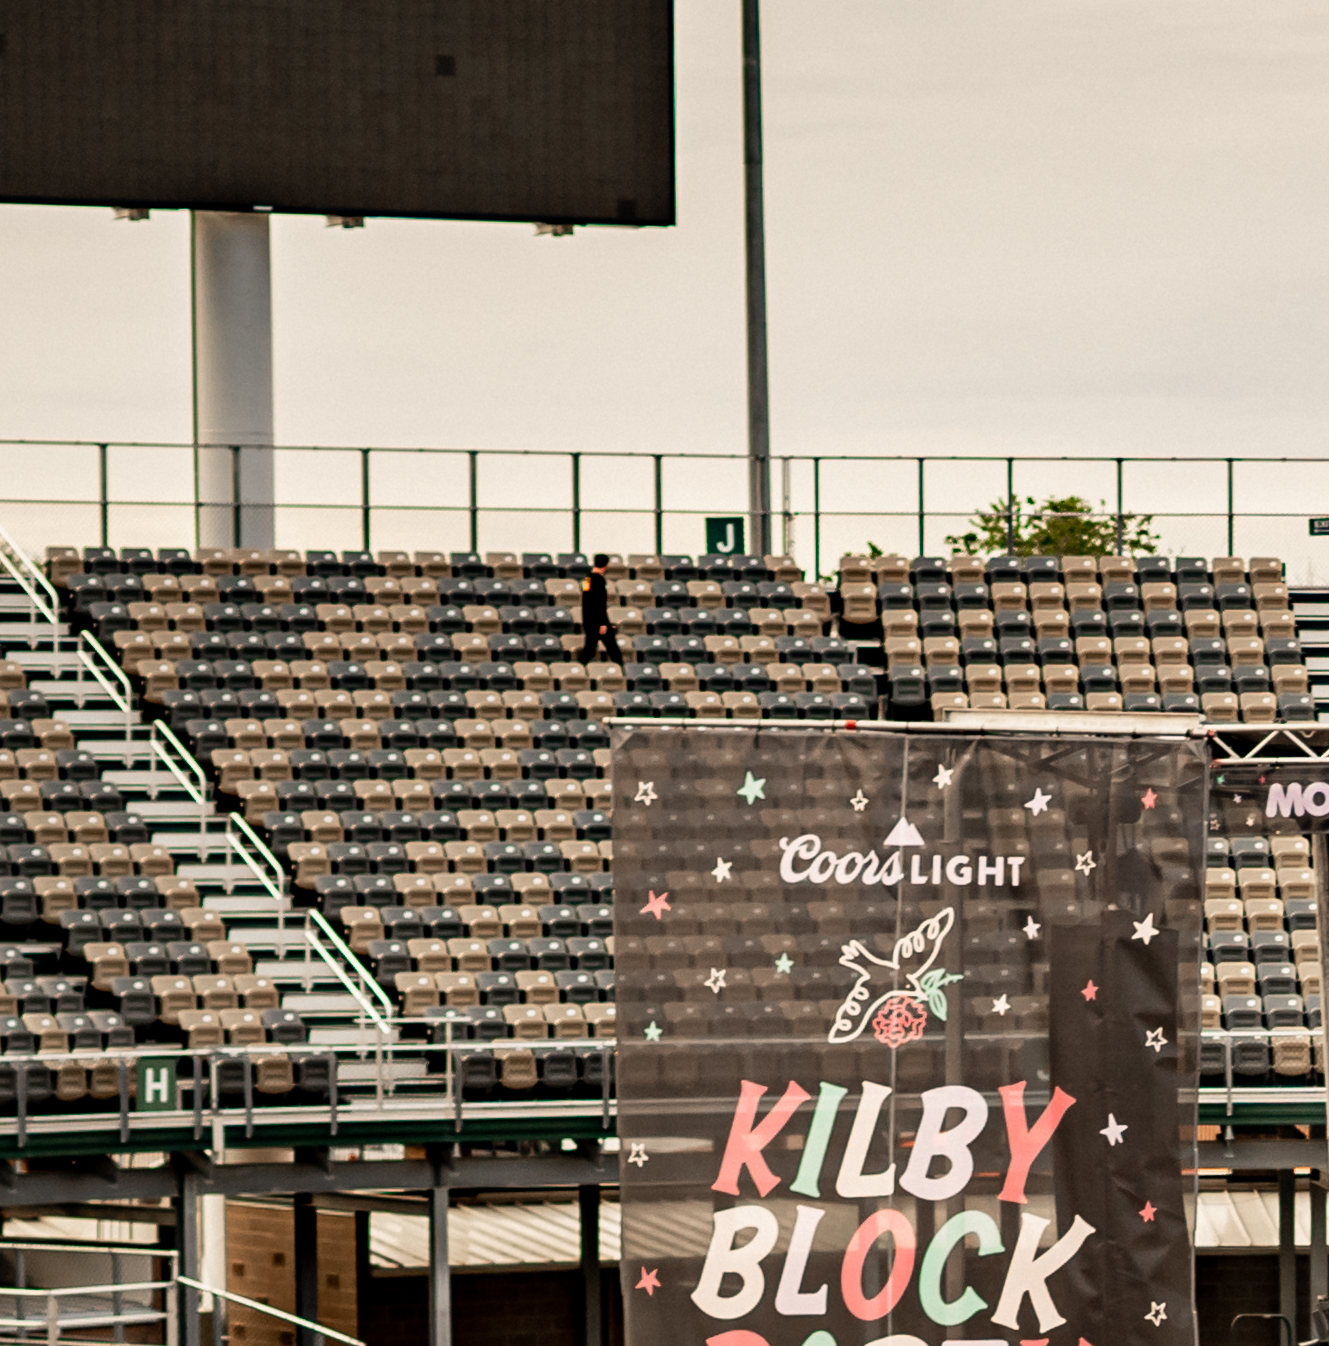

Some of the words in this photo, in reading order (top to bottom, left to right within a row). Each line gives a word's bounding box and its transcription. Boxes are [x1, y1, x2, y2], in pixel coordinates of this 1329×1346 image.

[716, 523, 735, 553] J
[778, 834, 904, 886] Coors
[910, 855, 1026, 887] LIGHT
[145, 1067, 169, 1104] H
[711, 1079, 1077, 1204] KILBY
[690, 1204, 1097, 1334] BLOCK
